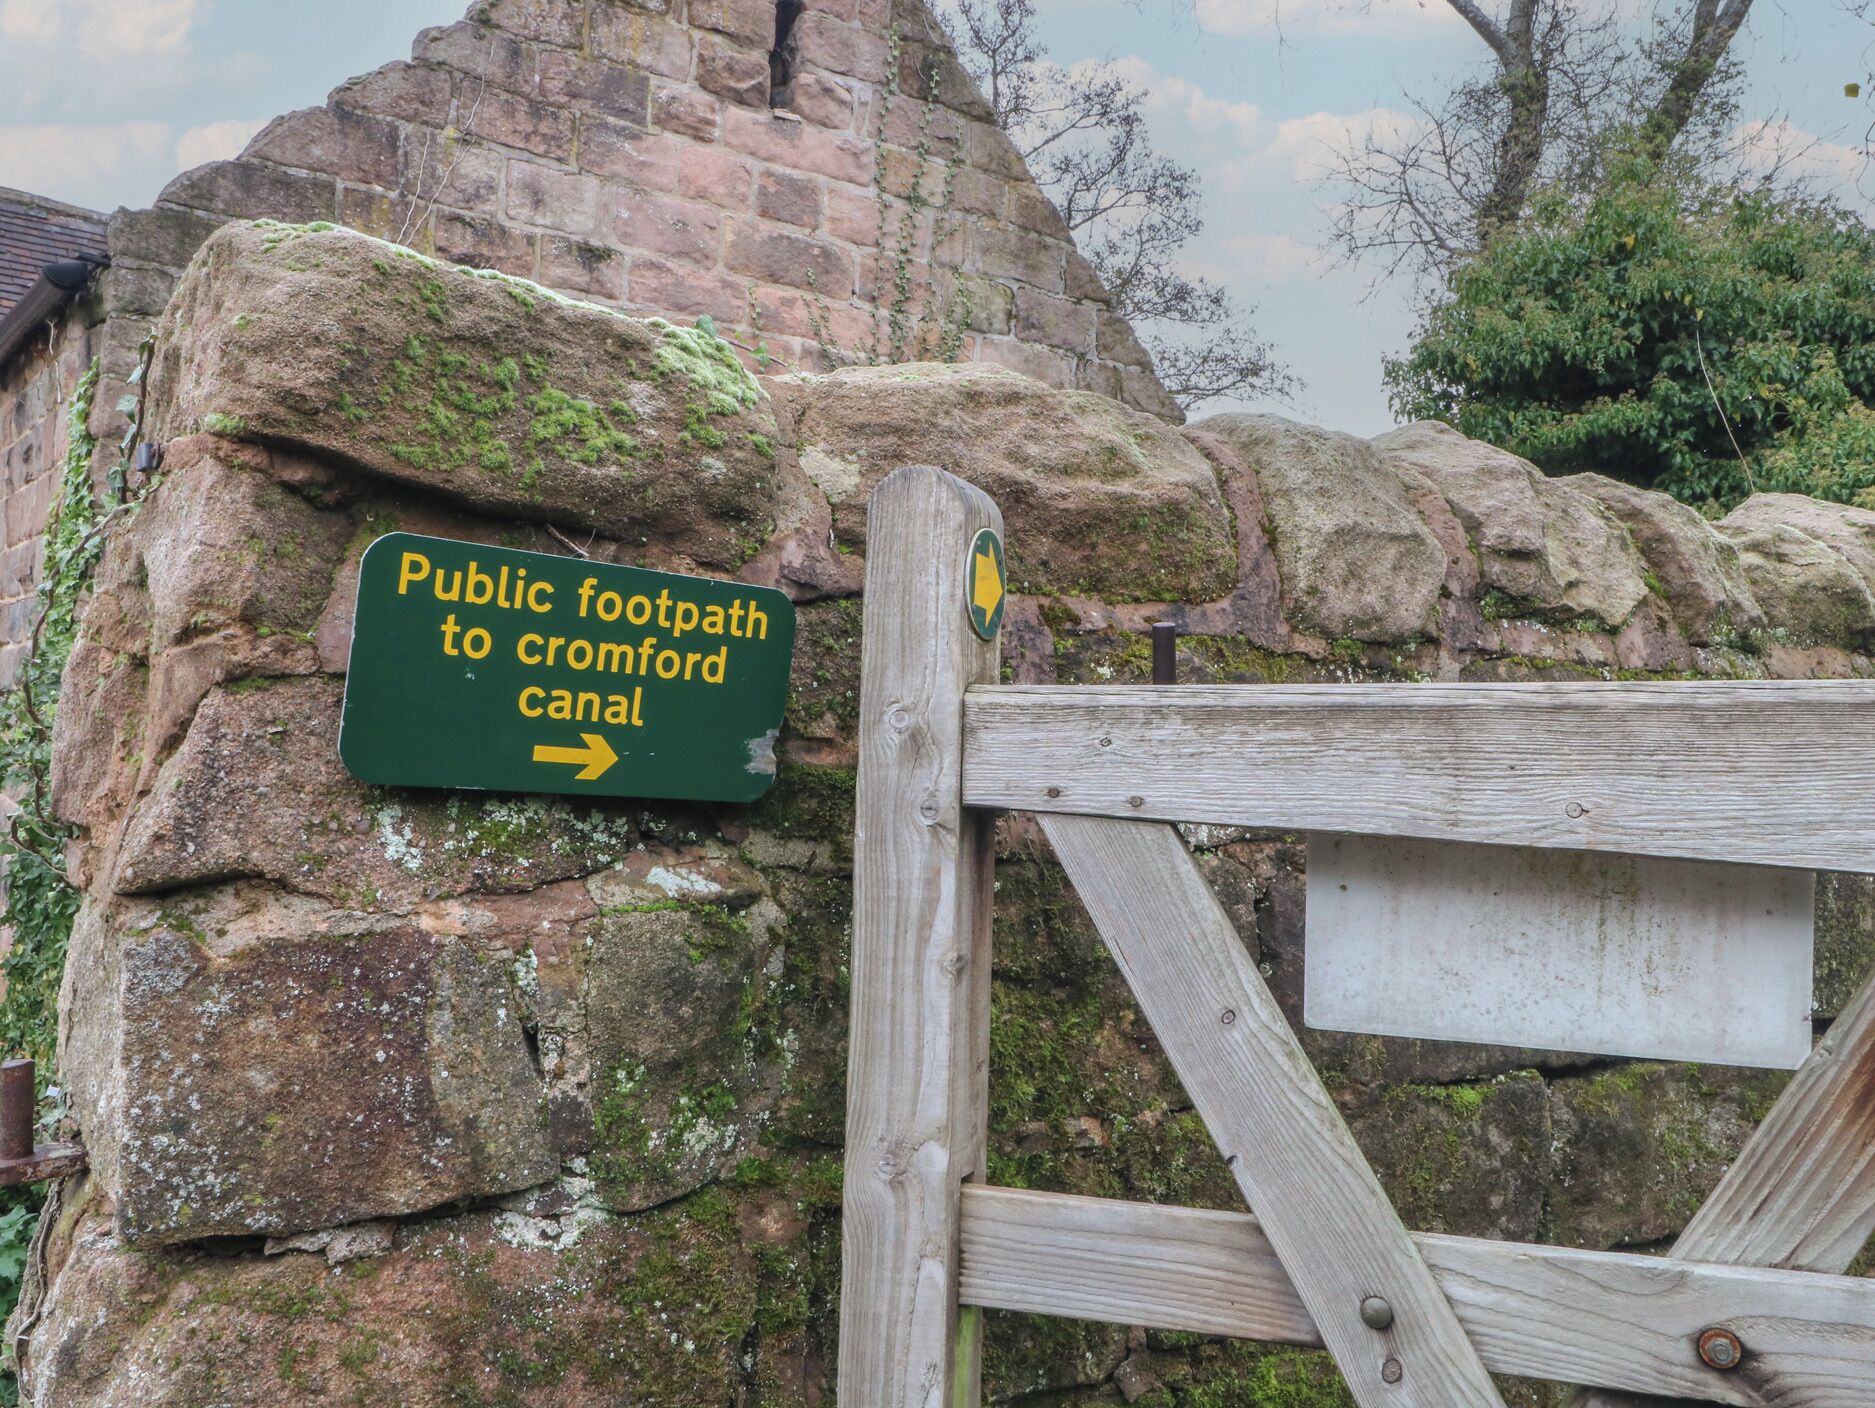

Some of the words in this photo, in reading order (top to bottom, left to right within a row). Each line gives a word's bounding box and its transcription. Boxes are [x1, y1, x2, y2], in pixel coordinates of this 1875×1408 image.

[398, 551, 555, 613] Public
[578, 577, 769, 640] footpath
[440, 613, 493, 660] to
[516, 633, 728, 684] cromford
[518, 686, 644, 727] canal
